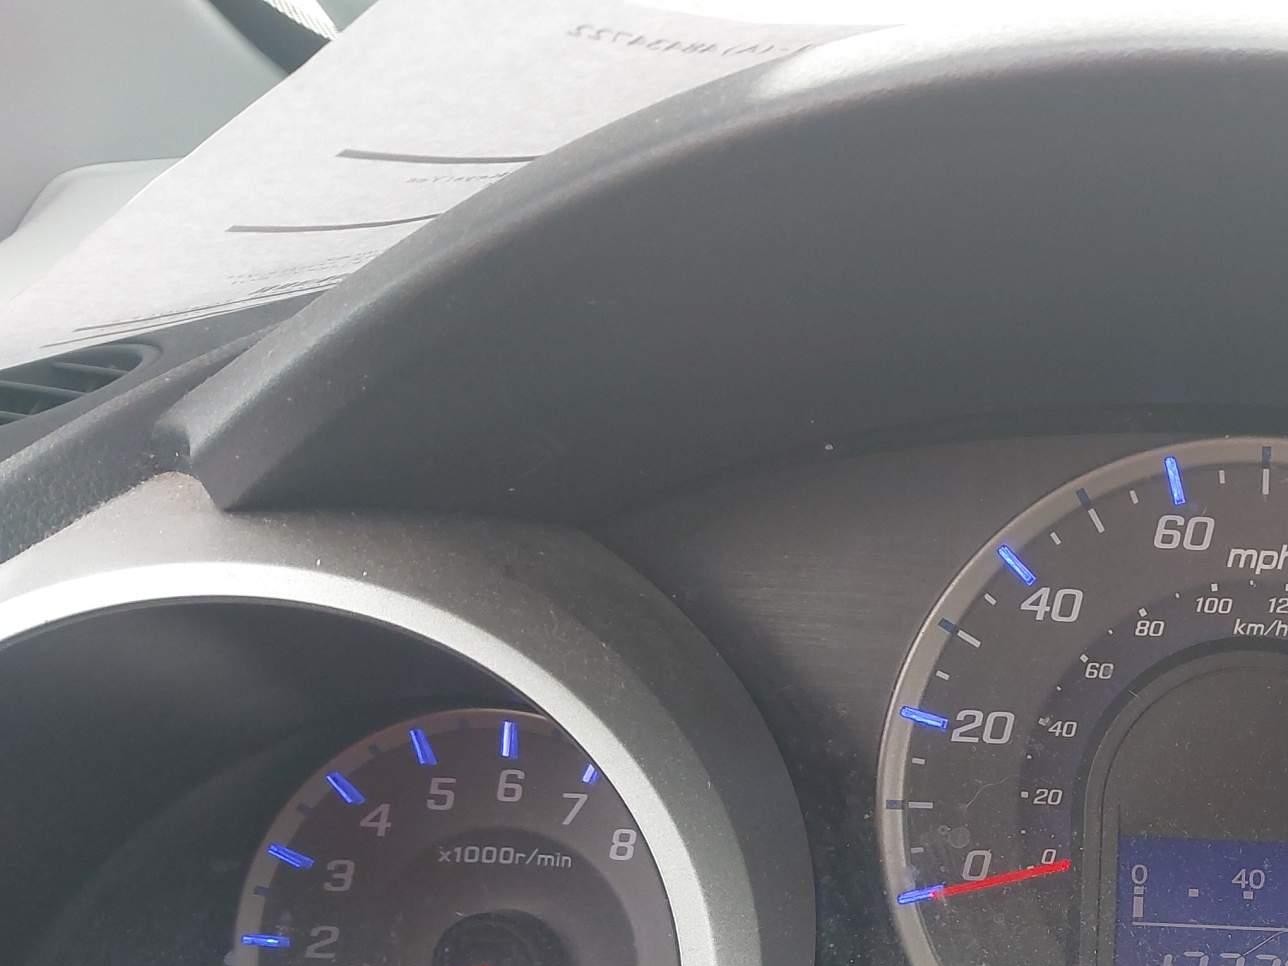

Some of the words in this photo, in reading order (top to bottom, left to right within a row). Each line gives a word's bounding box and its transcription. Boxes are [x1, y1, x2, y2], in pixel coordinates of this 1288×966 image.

[1153, 515, 1215, 551] 60
[1020, 587, 1084, 622] 40
[1195, 597, 1233, 614] 100
[1135, 620, 1164, 637] 80
[1232, 618, 1288, 637] km/h
[1085, 662, 1114, 679] 60
[950, 709, 1015, 744] 20
[1048, 720, 1078, 737] 40
[426, 777, 457, 811] 5
[496, 769, 525, 802] 6
[1033, 788, 1063, 805] 20
[359, 803, 392, 837] 4
[562, 792, 588, 825] 7
[437, 846, 572, 869] x1000r/min
[608, 828, 638, 861] 8
[1041, 849, 1057, 864] 0
[323, 859, 356, 892] 3
[962, 850, 992, 881] 0
[1131, 864, 1148, 885] 0
[1231, 868, 1265, 889] 40
[304, 925, 340, 959] 2
